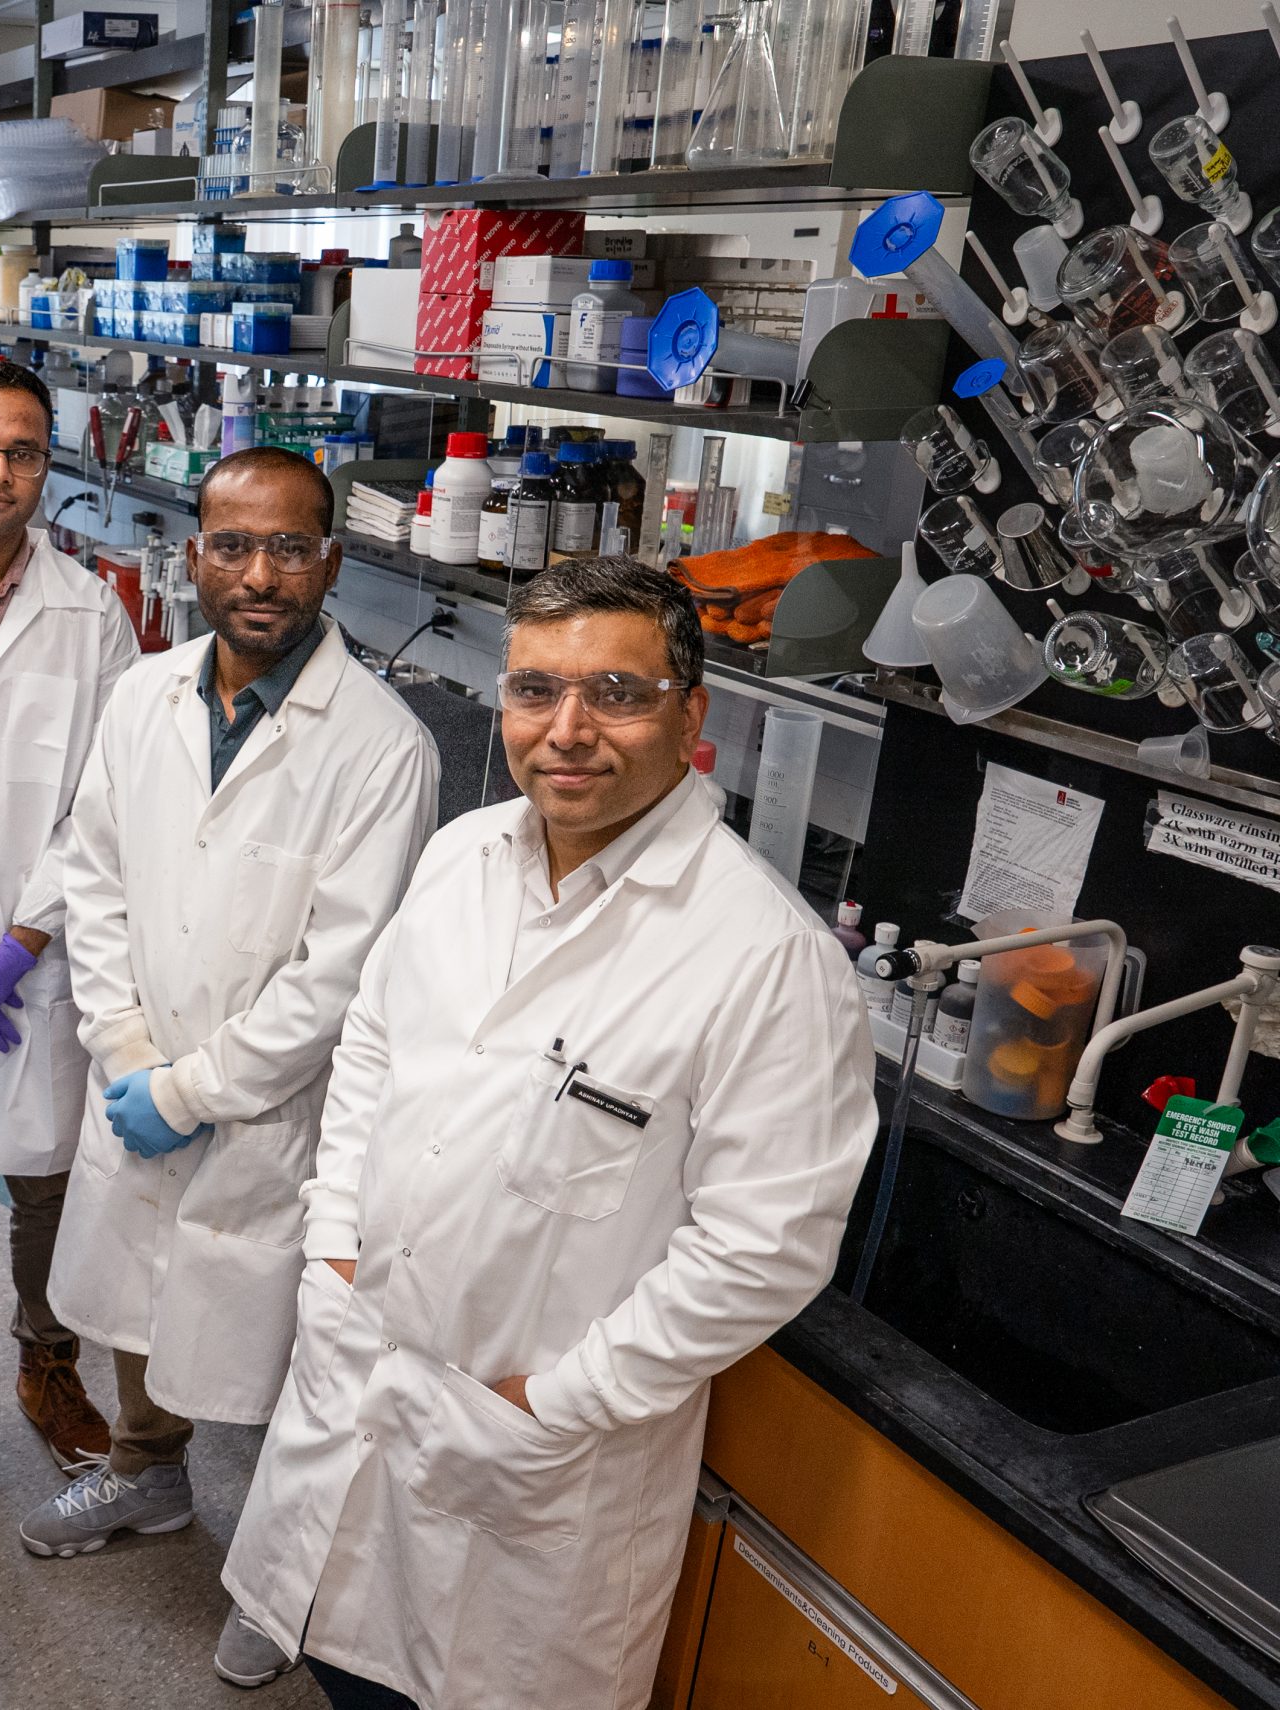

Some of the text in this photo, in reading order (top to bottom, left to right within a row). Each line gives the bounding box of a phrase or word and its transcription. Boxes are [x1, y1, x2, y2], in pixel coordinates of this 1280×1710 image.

[483, 220, 503, 242] QIAGEN
[522, 228, 541, 249] QIAGEN
[472, 248, 492, 271] QIAGEN
[516, 344, 530, 352] without
[1171, 802, 1280, 848] Glassware rinsin
[1186, 826, 1216, 841] with
[1220, 835, 1257, 855] warm
[1163, 832, 1181, 847] 3X
[1184, 841, 1212, 857] with
[1216, 850, 1268, 876] distilled
[578, 1090, 638, 1121] ABHINAV UPADHYAY
[1165, 1110, 1237, 1133] EMERGENCY SHOWER
[1176, 1121, 1220, 1138] & EYE WASH
[1171, 1128, 1219, 1147] TEST RECORD
[738, 1542, 889, 1688] Decontaminants&Cleaning Products
[808, 1640, 830, 1667] B-1
